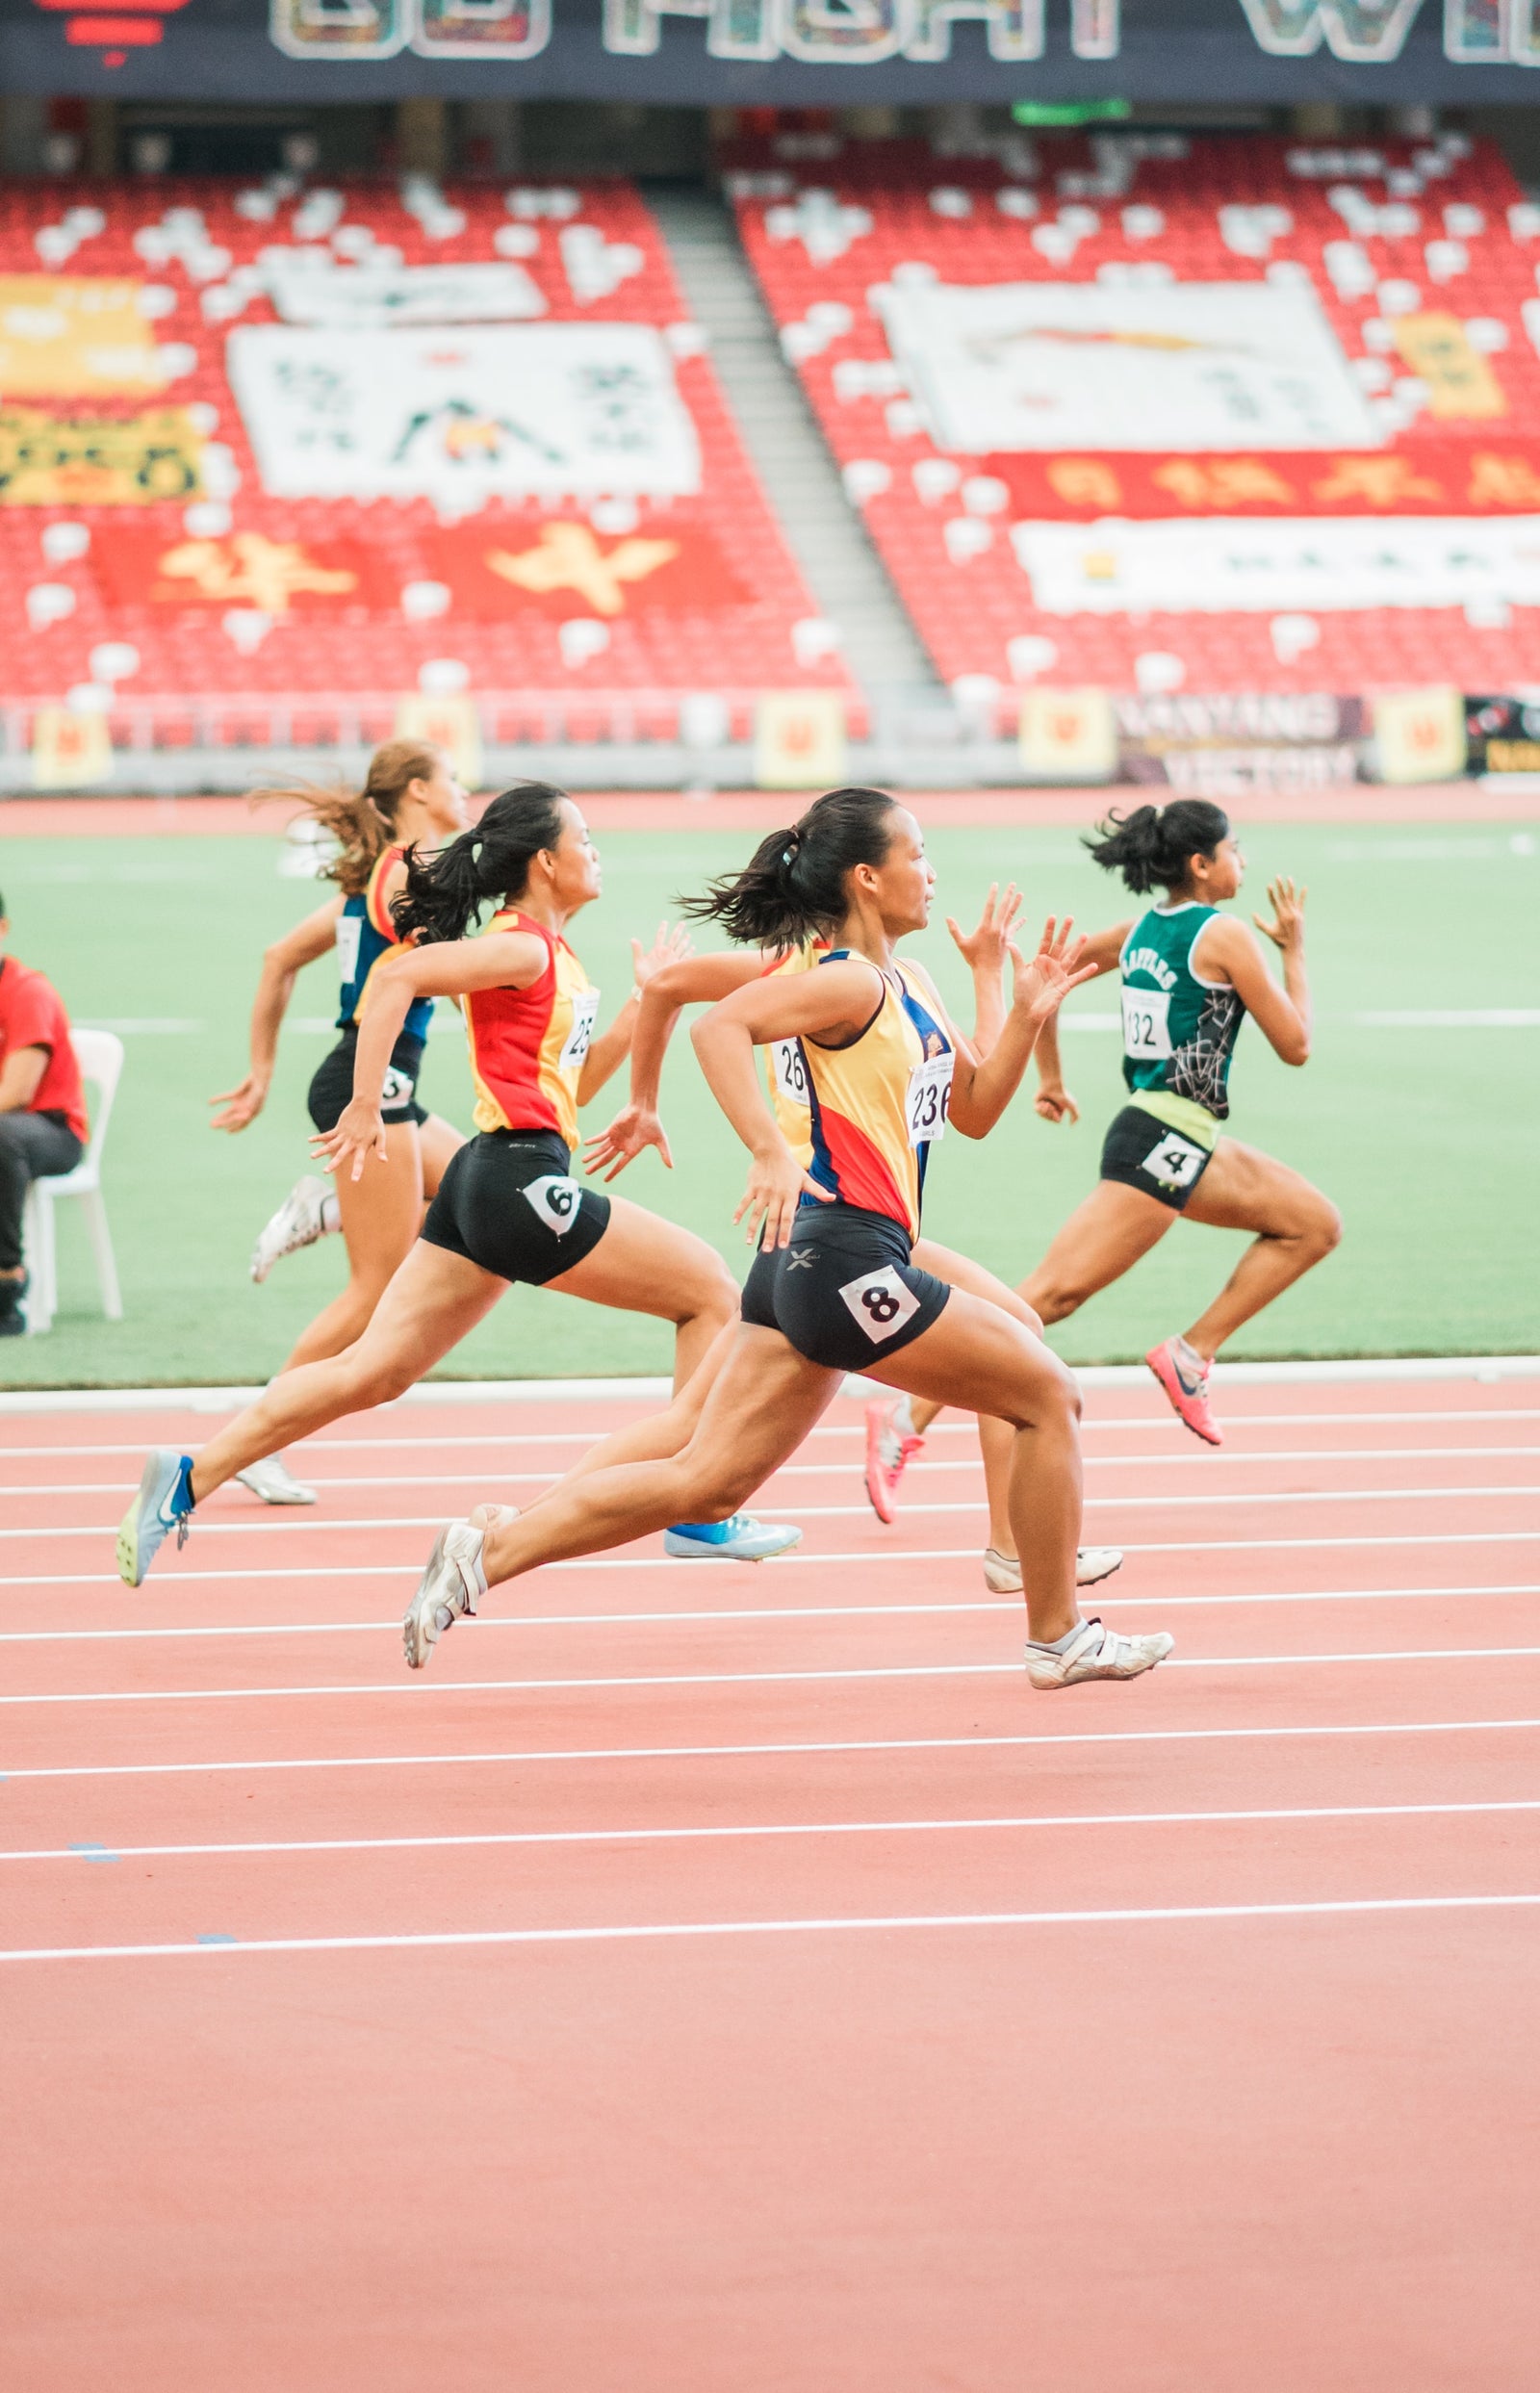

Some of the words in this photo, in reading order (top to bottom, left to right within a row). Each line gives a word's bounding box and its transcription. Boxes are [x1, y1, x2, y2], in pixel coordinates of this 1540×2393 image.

[782, 1044, 808, 1092] 26
[1163, 1151, 1188, 1175] 4
[546, 1184, 574, 1217] 6
[861, 1286, 900, 1324] 8
